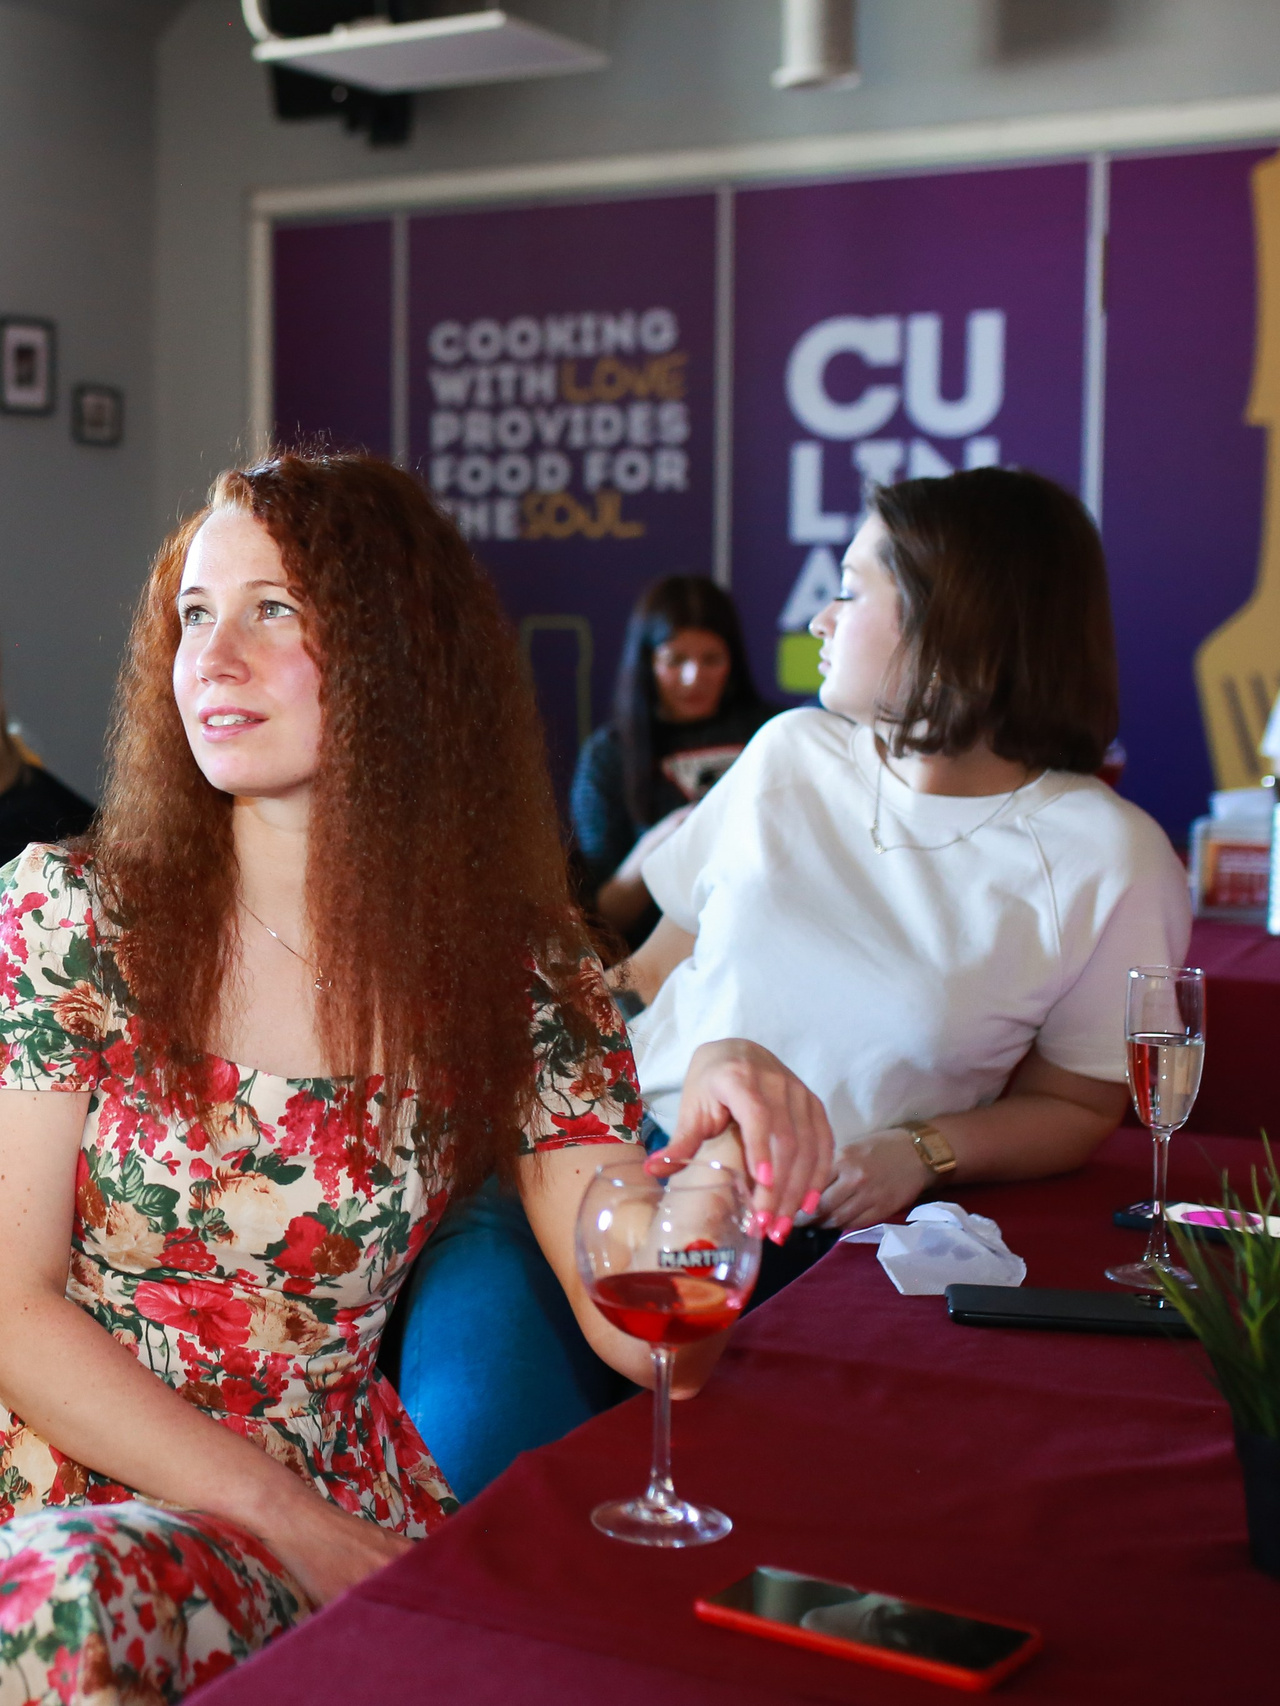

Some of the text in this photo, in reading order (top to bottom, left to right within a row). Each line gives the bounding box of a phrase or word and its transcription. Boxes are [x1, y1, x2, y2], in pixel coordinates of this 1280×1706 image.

[430, 308, 677, 362] COOKING
[430, 352, 687, 404] WITH LOVE
[786, 309, 1004, 440] CU
[430, 400, 689, 450] PROVIDES
[430, 447, 687, 496] FOOD FOR
[521, 489, 644, 538] SOUL
